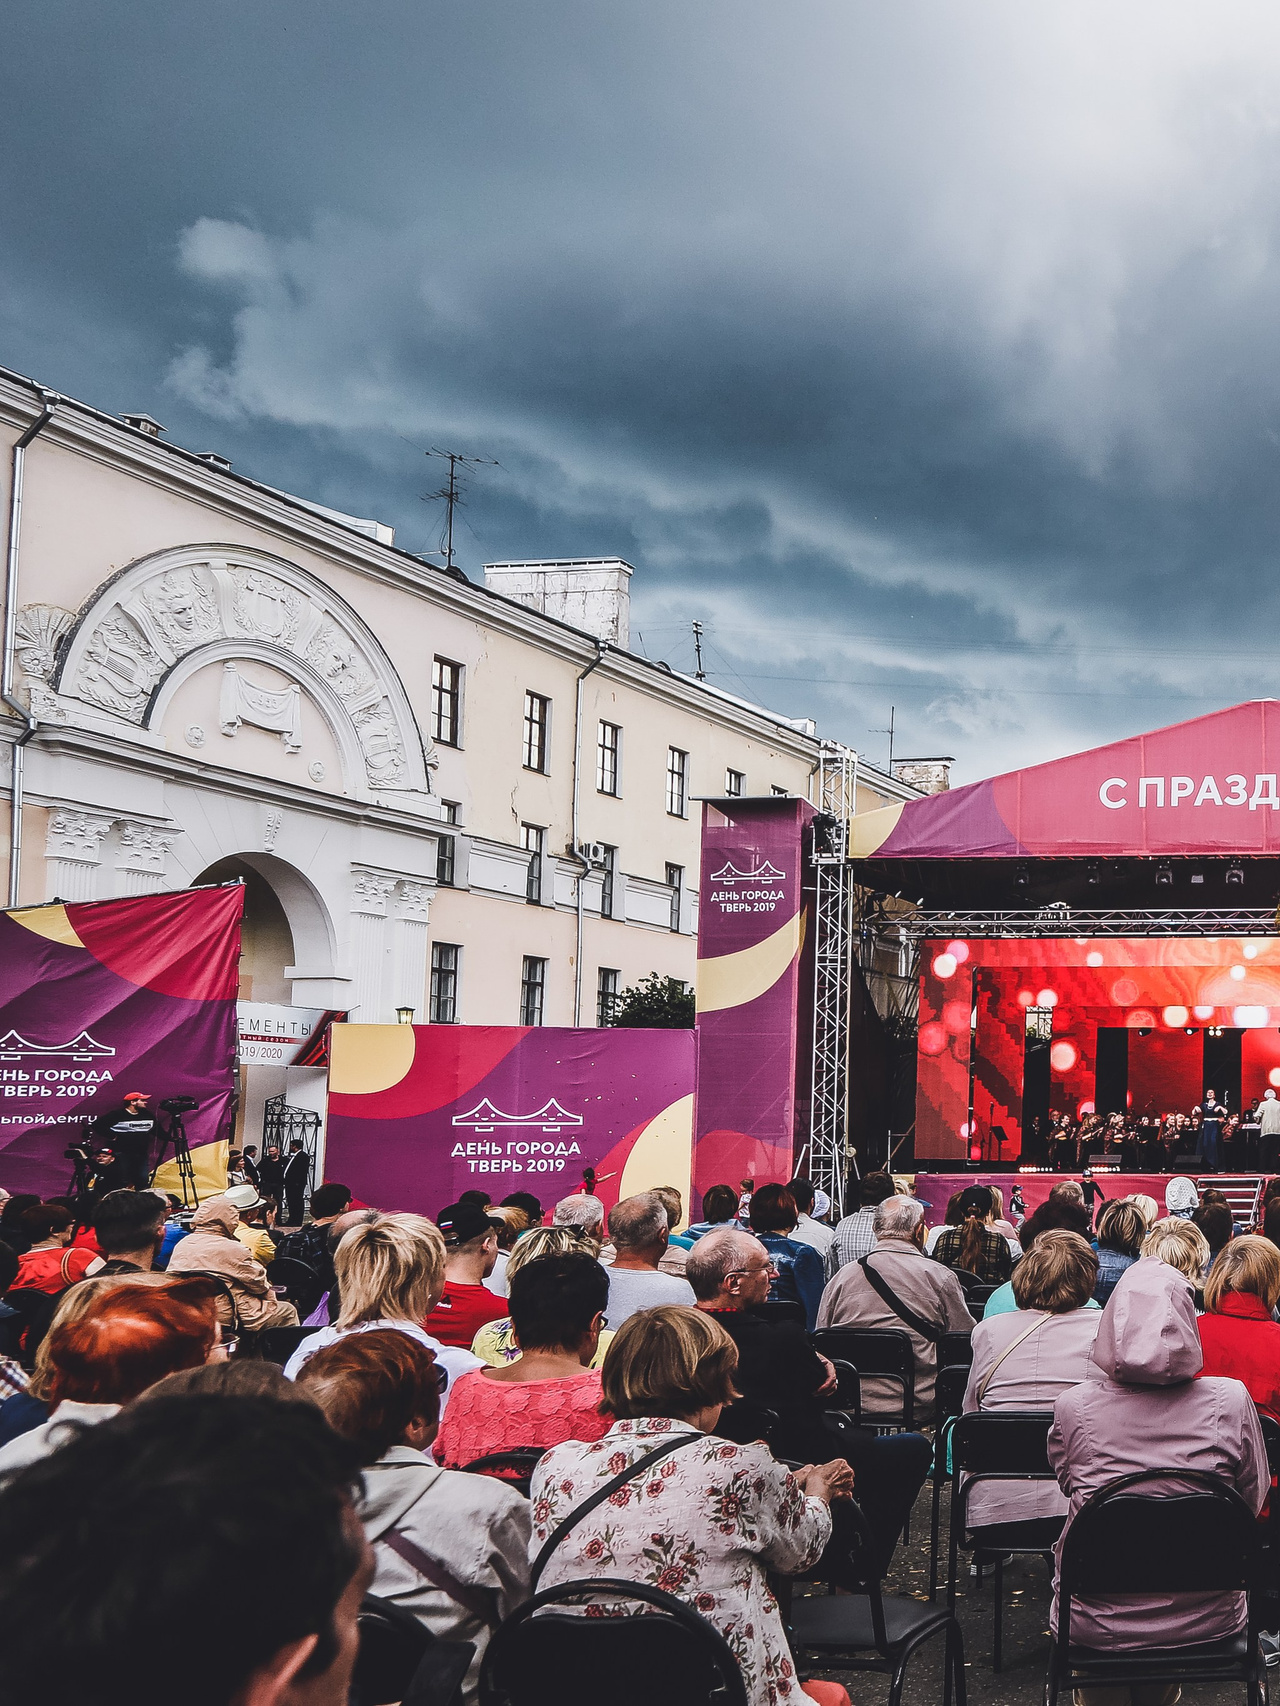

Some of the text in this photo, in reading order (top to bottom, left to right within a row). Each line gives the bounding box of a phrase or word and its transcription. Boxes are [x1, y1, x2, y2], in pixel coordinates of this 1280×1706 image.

[1100, 777, 1128, 810] С
[710, 890, 785, 902] ДЕНЬ ГОРОДА
[720, 902, 776, 913] ТВЕРЬ 2019
[238, 1017, 312, 1036] ЕМЕНТЫ
[0, 1069, 114, 1082] НЬ ГОРОДА
[56, 1085, 97, 1097] 2019
[451, 1141, 581, 1157] ДЕНЬ ГОРОДА
[467, 1159, 566, 1173] ТВЕРЬ 2019
